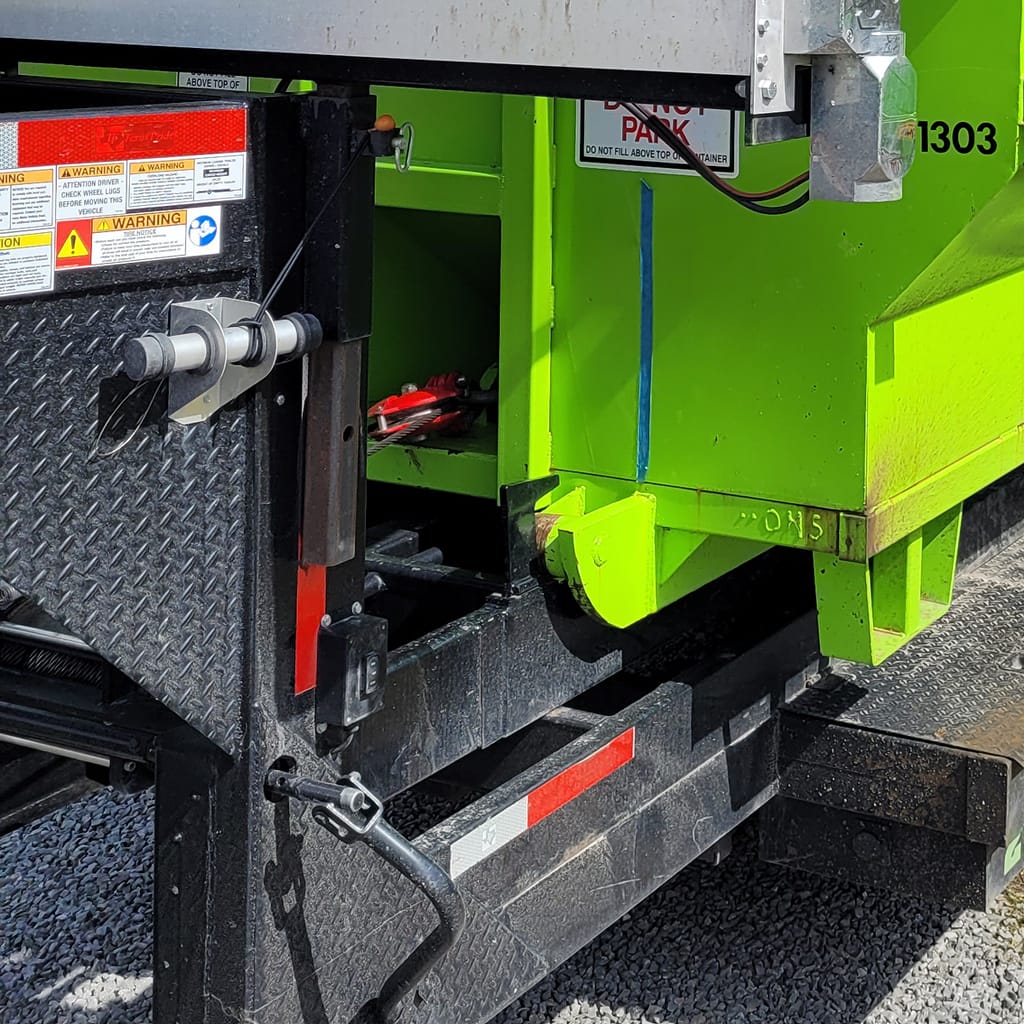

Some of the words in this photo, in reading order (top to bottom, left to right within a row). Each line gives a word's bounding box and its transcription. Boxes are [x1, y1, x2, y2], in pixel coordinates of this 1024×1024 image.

[186, 77, 212, 88] ABOVE
[213, 79, 228, 89] TOP
[229, 80, 240, 90] OF
[917, 120, 998, 155] 1303
[585, 145, 597, 154] DO
[598, 146, 613, 156] NOT
[614, 147, 629, 157] FILL
[630, 148, 655, 158] ABOVE
[656, 150, 671, 160] TOP
[695, 153, 728, 164] NTAINER
[72, 164, 121, 176] WARNING
[147, 161, 185, 171] WARNING
[62, 180, 96, 189] ATTENTION
[97, 178, 120, 186] DRIVER
[61, 189, 81, 198] CHECK
[83, 188, 104, 197] WHEEL
[105, 187, 121, 195] LUGS
[58, 199, 82, 208] BEFORE
[84, 198, 108, 207] MOVING
[109, 196, 123, 204] THIS
[78, 206, 104, 215] VEHICLE
[112, 212, 181, 229] WARNING
